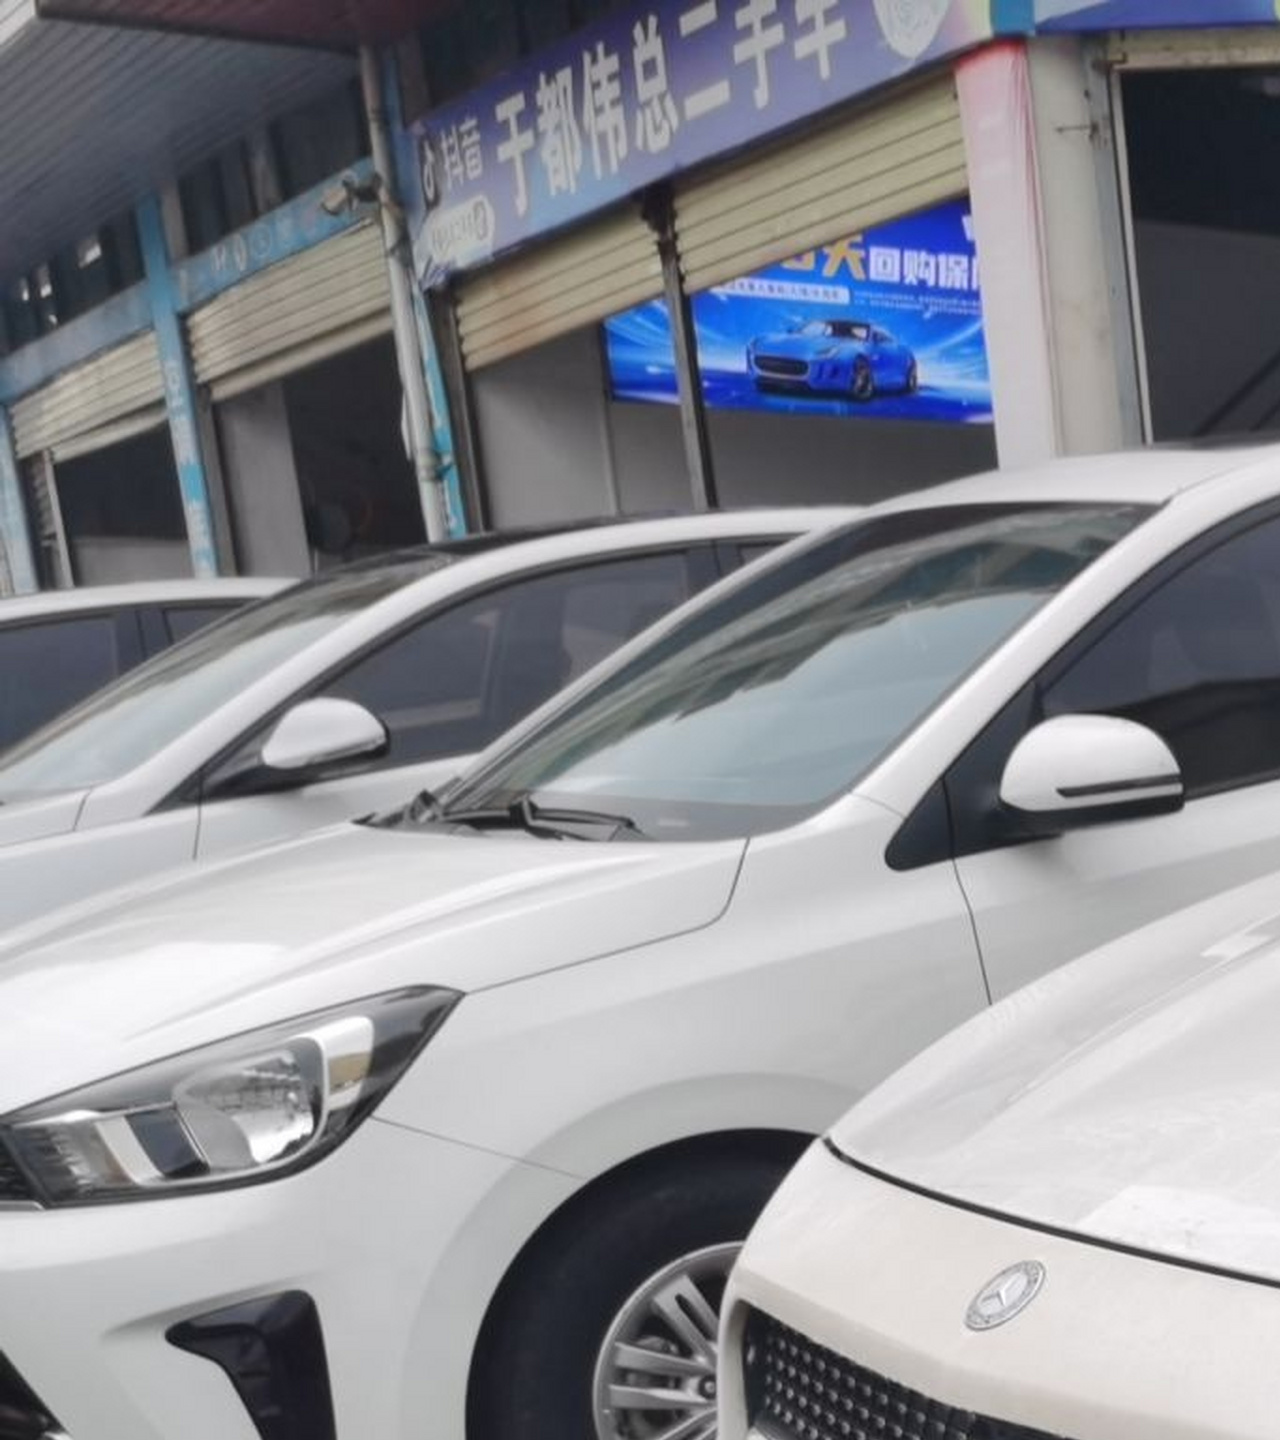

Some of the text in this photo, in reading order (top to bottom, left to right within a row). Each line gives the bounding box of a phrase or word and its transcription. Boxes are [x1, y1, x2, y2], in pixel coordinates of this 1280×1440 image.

[441, 0, 847, 217] 抖音 于都伟总二手车
